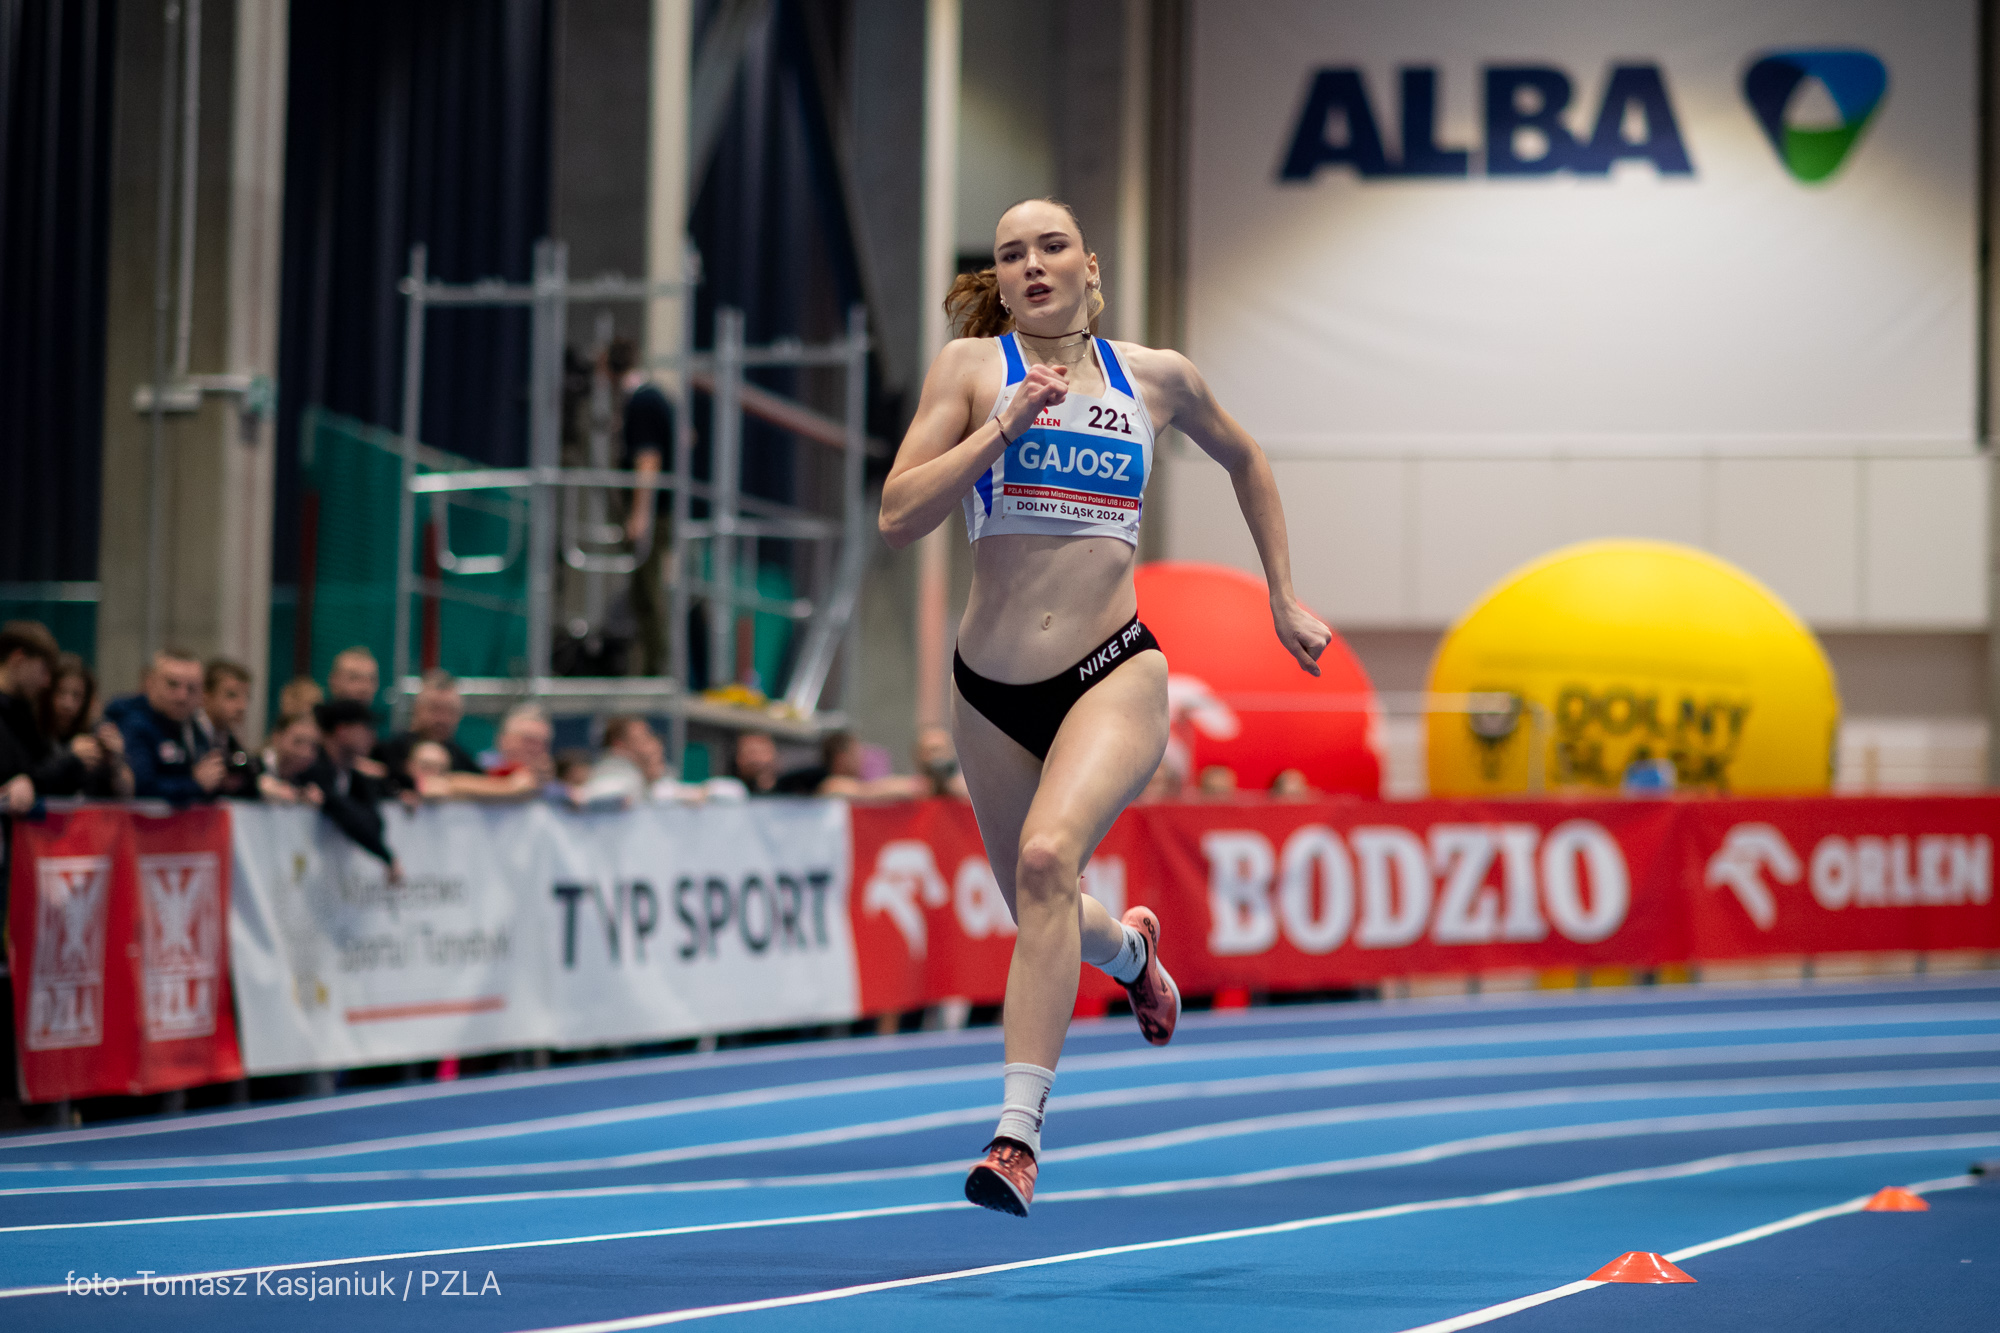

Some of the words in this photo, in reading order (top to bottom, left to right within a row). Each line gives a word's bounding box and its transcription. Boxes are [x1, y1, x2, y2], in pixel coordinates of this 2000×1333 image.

[1280, 66, 1697, 180] ALBA
[1034, 417, 1061, 427] RLEN
[1088, 405, 1132, 435] 221
[1018, 441, 1132, 482] GAJOSZ
[1016, 501, 1058, 513] DOLNY
[1060, 502, 1094, 519] ŚLĄSK
[1096, 509, 1125, 522] 2024
[1023, 488, 1050, 497] Halowe
[1050, 490, 1087, 502] Mistrzostwa
[1087, 495, 1106, 504] Polski
[1106, 498, 1118, 506] U18
[1122, 500, 1135, 508] U20
[1079, 640, 1121, 681] NIKE
[1203, 819, 1629, 955] BODZIO
[1810, 833, 1993, 909] ORLEN
[552, 878, 658, 970] TVP
[674, 870, 834, 960] SPORT
